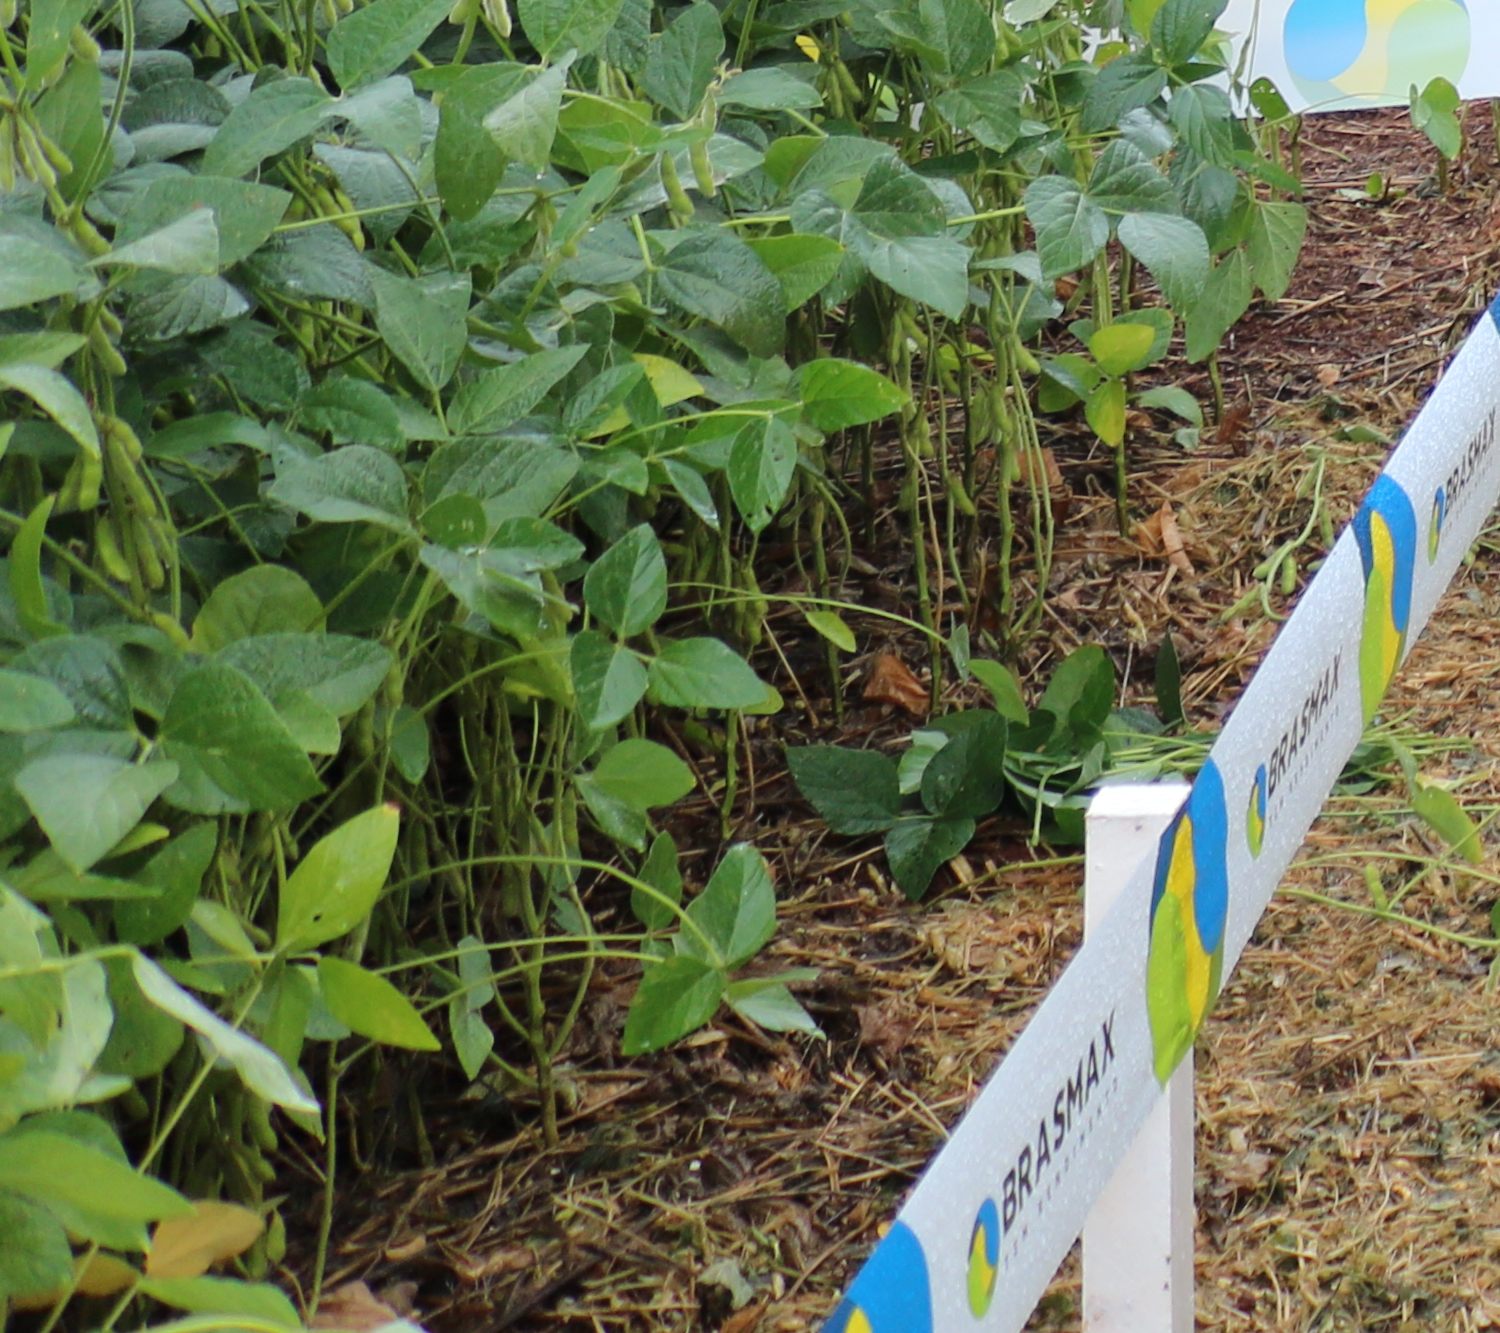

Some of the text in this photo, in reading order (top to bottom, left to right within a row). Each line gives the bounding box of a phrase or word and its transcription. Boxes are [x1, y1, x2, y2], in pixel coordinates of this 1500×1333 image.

[1444, 405, 1496, 520] BRASMAX
[1268, 644, 1343, 800] BRASMAX
[1002, 1008, 1116, 1235] BRASMAX
